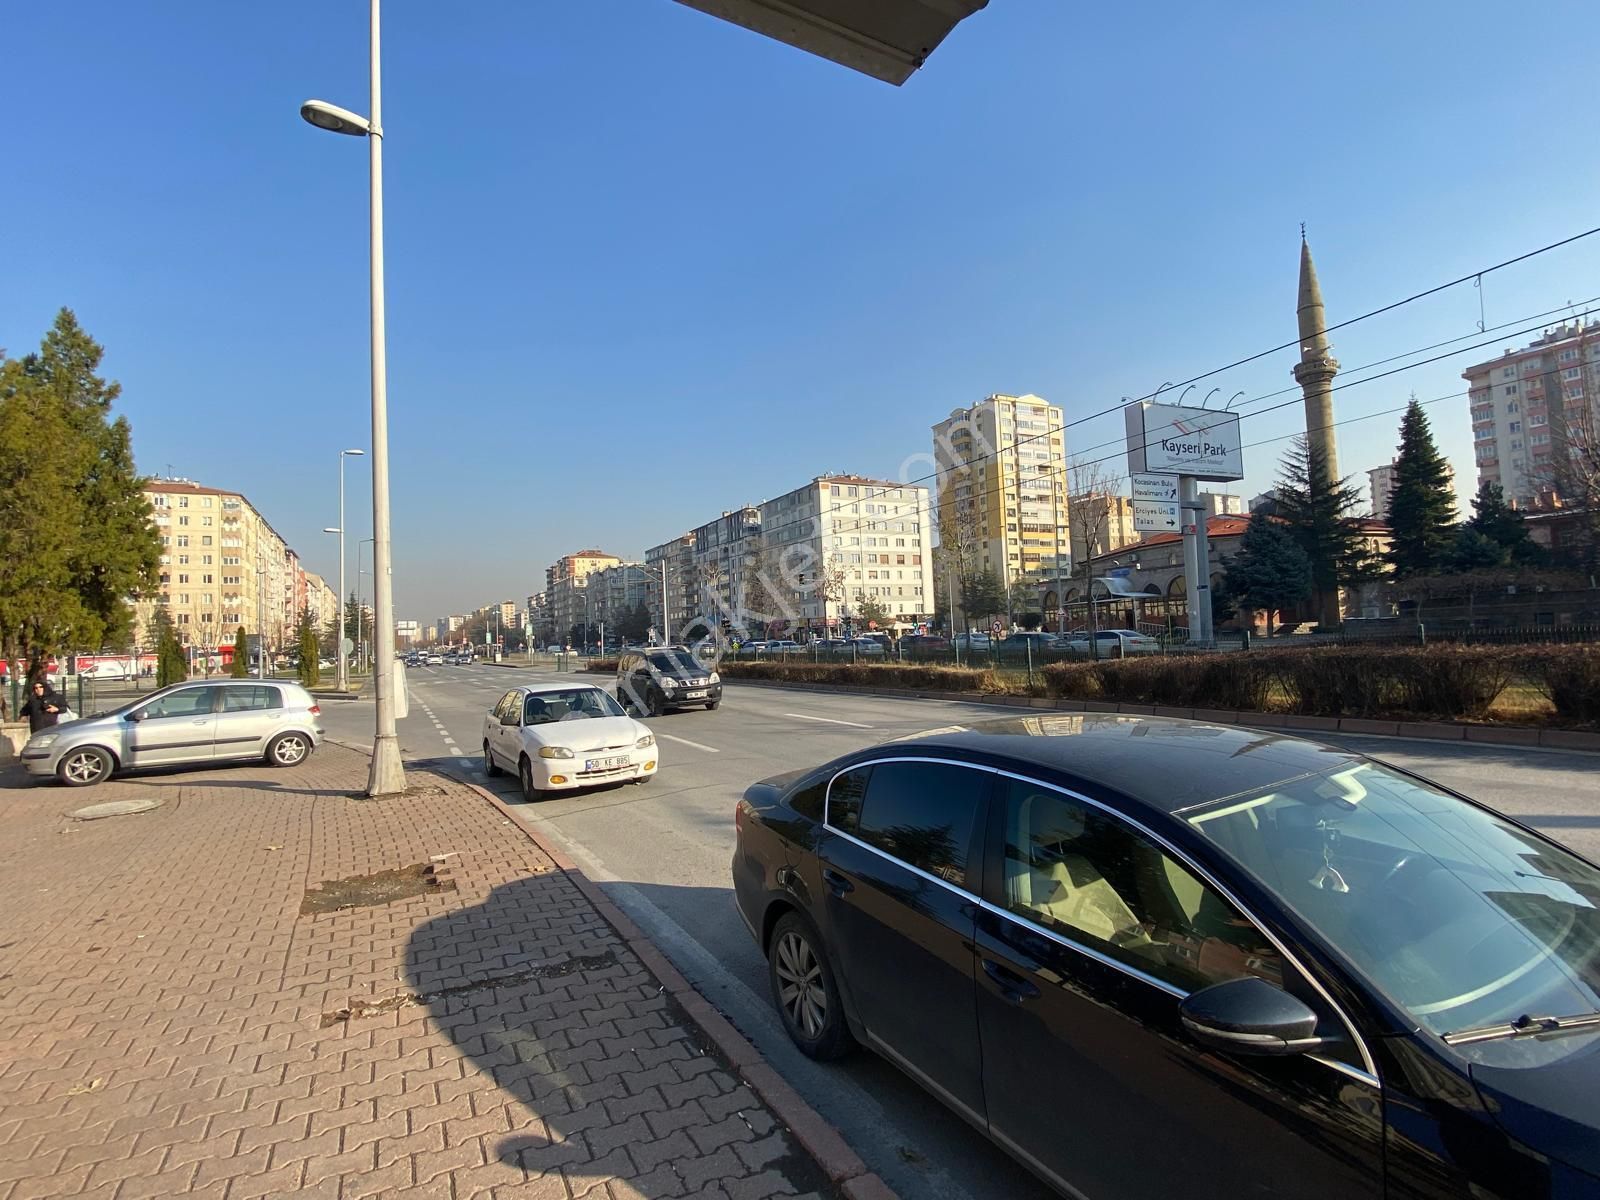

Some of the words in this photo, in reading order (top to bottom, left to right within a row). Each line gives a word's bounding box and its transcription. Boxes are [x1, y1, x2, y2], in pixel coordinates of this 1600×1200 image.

[1161, 439, 1200, 456] Kayseri
[1204, 443, 1227, 457] Park
[1135, 507, 1157, 516] Erciyes
[1136, 517, 1154, 525] Talas
